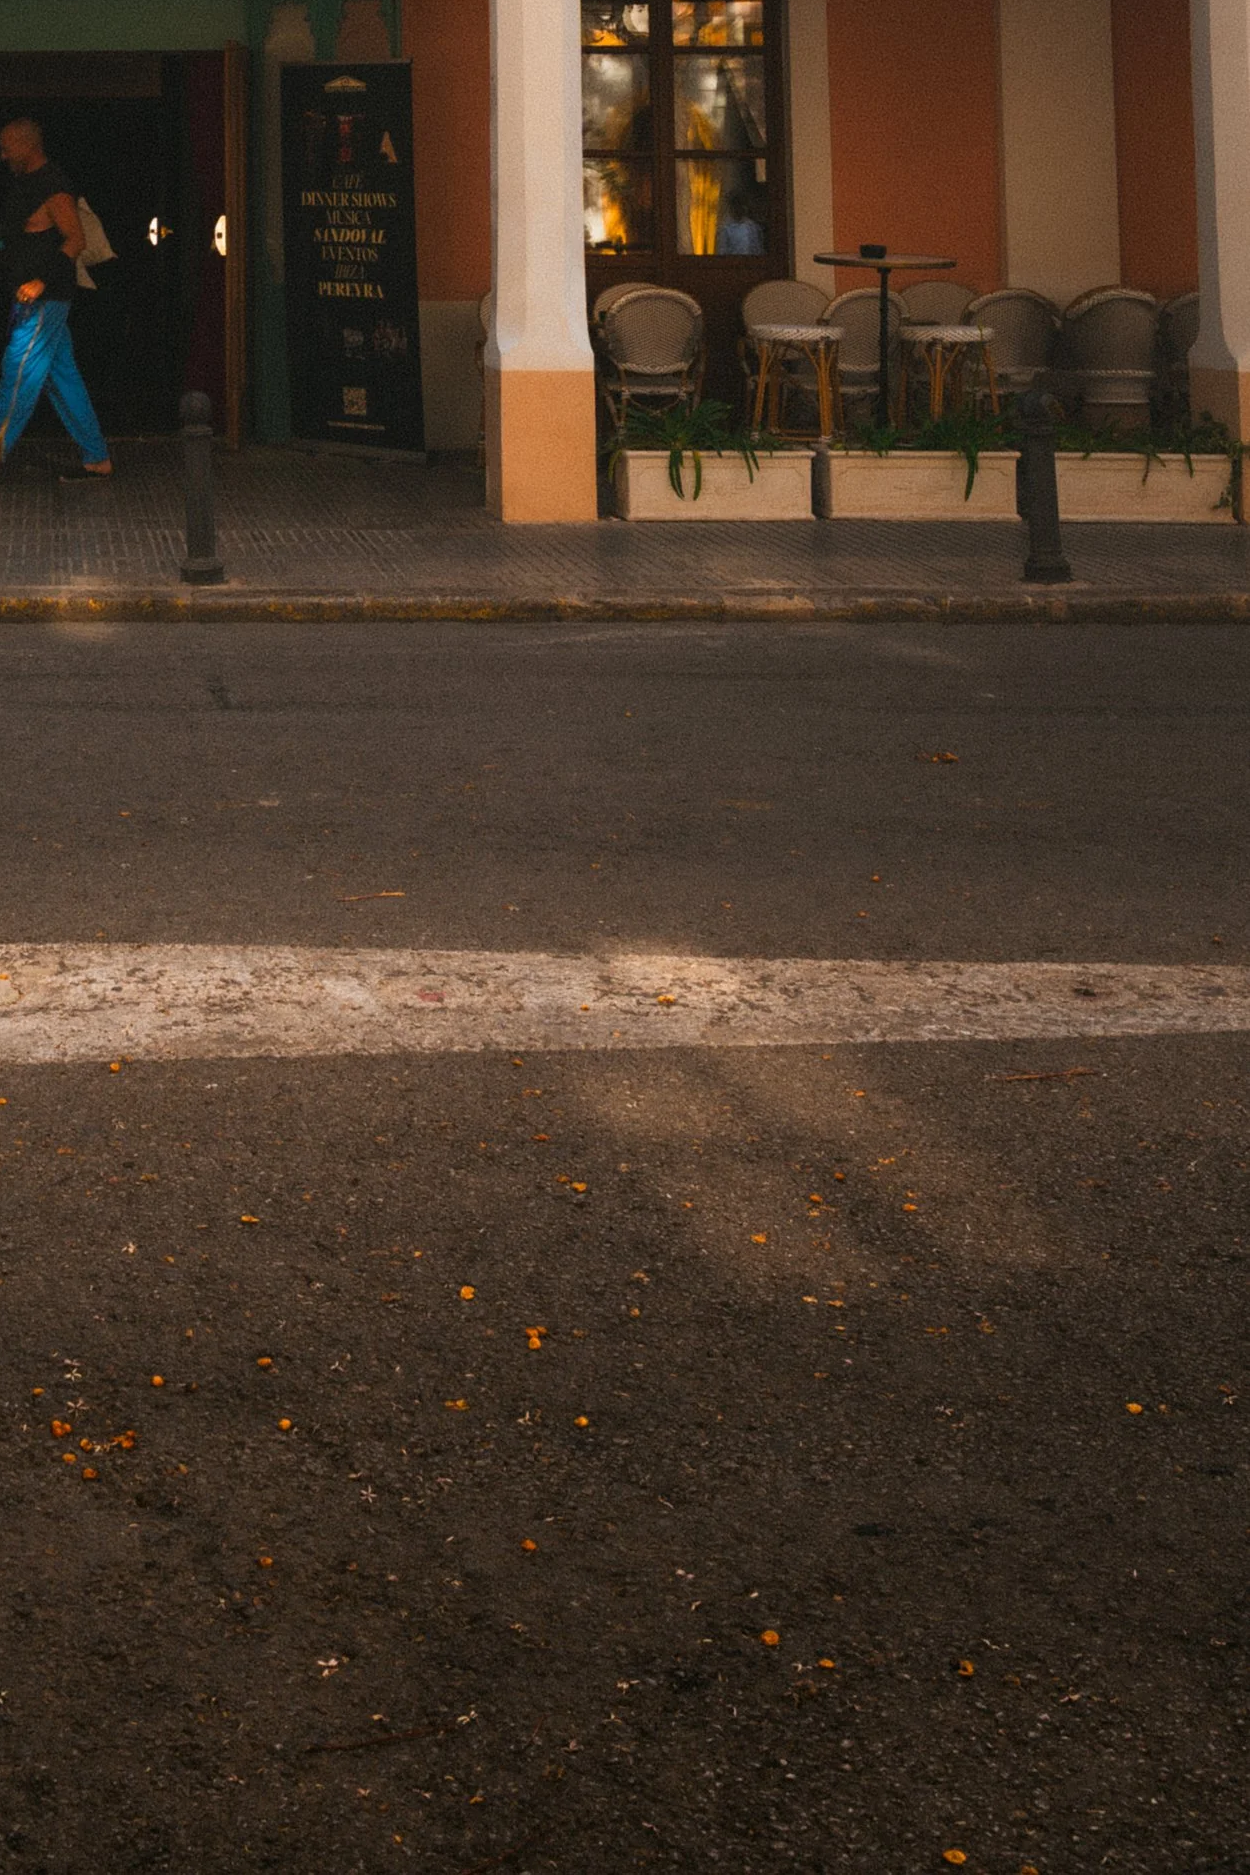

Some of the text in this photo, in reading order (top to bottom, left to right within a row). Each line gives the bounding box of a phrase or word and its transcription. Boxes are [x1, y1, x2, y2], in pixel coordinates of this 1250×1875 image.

[301, 191, 397, 207] DINNER SHOWS
[313, 228, 387, 243] SANDOVAL
[321, 245, 379, 262] EVENTOS
[318, 281, 385, 299] PEREYRA
